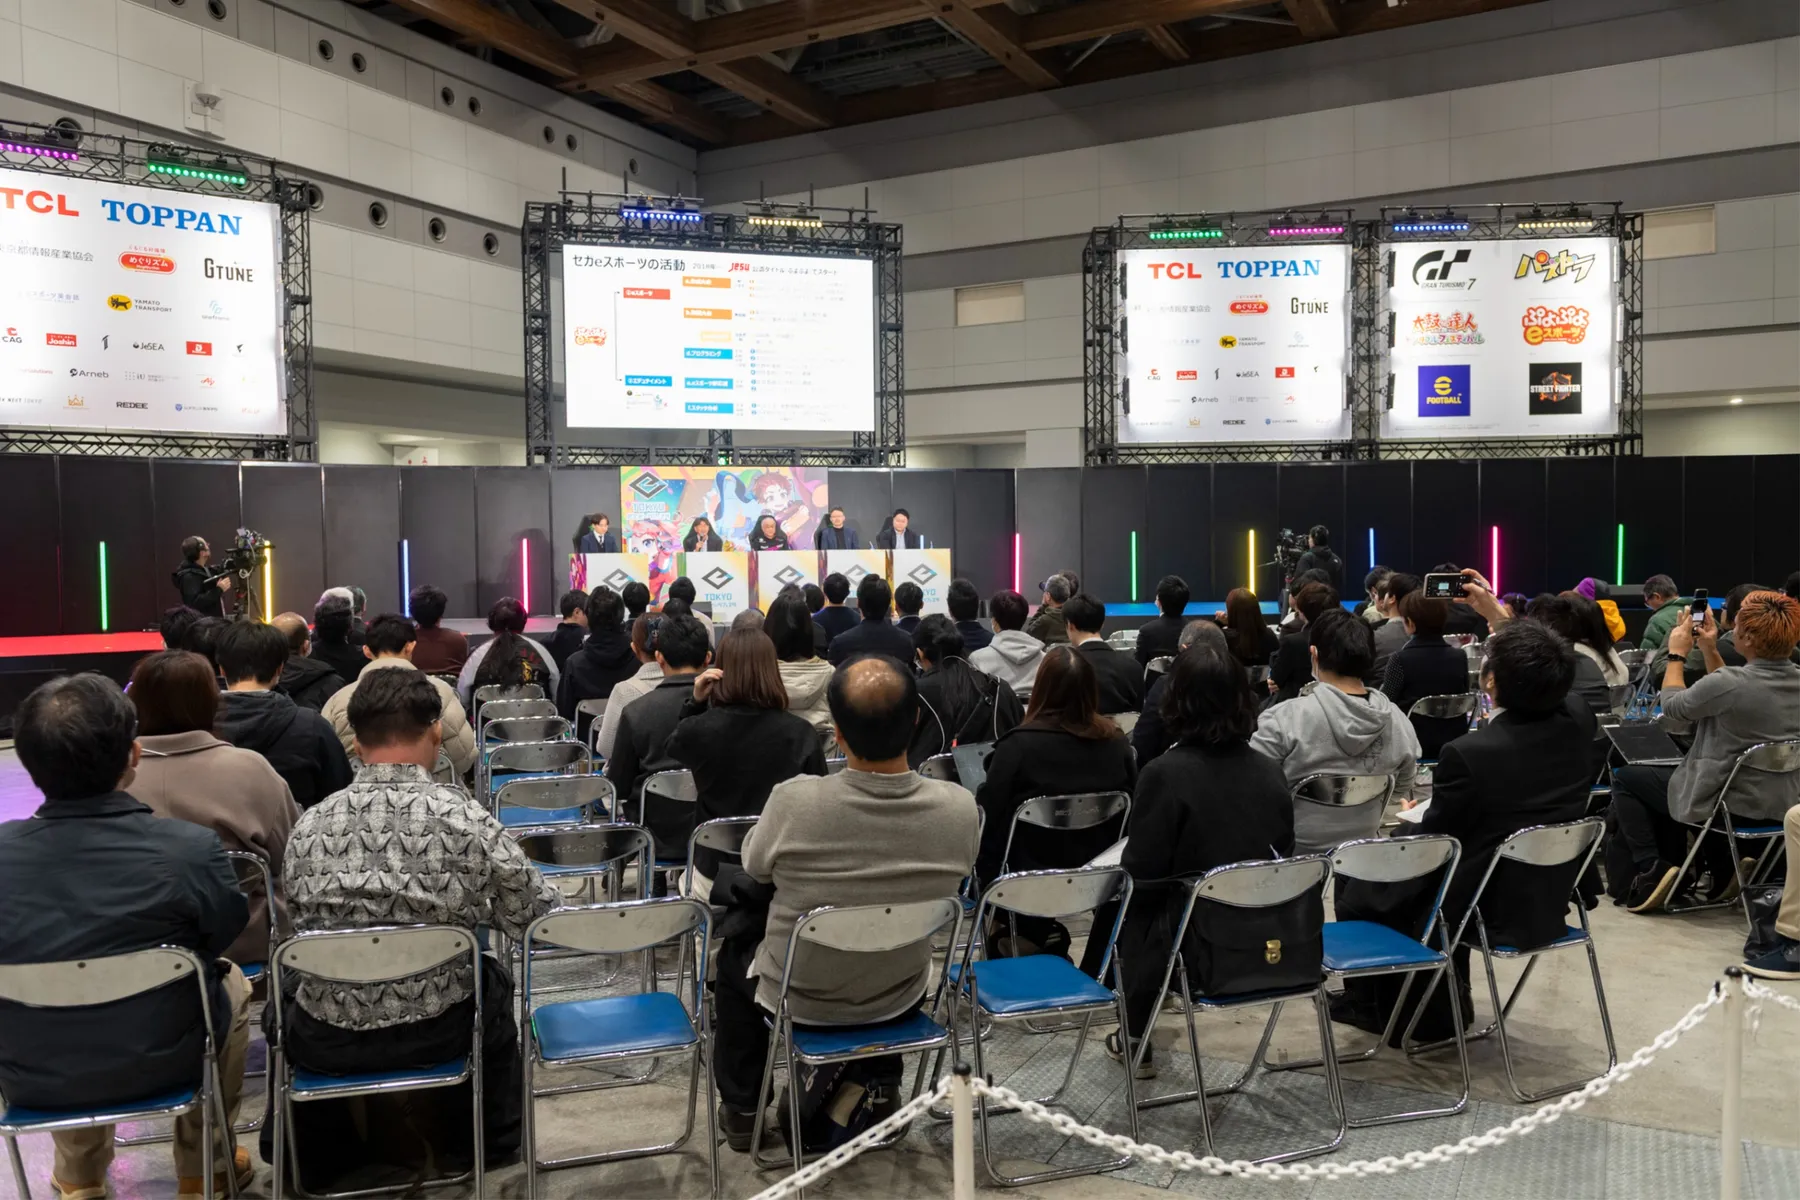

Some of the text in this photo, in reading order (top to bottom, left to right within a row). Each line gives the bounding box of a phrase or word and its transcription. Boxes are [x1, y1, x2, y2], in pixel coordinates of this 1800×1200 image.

[0, 187, 243, 236] TCL TOPPAN
[129, 256, 168, 267] めぐりズム
[573, 254, 686, 272] セカeスポーツの活動
[1147, 259, 1322, 280] TCL TOPPAN
[1440, 281, 1466, 289] TURISMO
[1467, 278, 1477, 290] 7
[135, 305, 172, 313] TRANSPORT
[1522, 306, 1588, 329] ぷよぷよ
[1525, 325, 1581, 343] eスポーツ
[2, 336, 22, 344] CAG
[48, 338, 75, 346] Joshin
[79, 370, 109, 379] Arneb
[1530, 385, 1581, 393] STREET FIGHTER
[1426, 396, 1461, 405] FOOTBALL
[116, 401, 148, 410] REDEE
[704, 592, 733, 601] TOKYO
